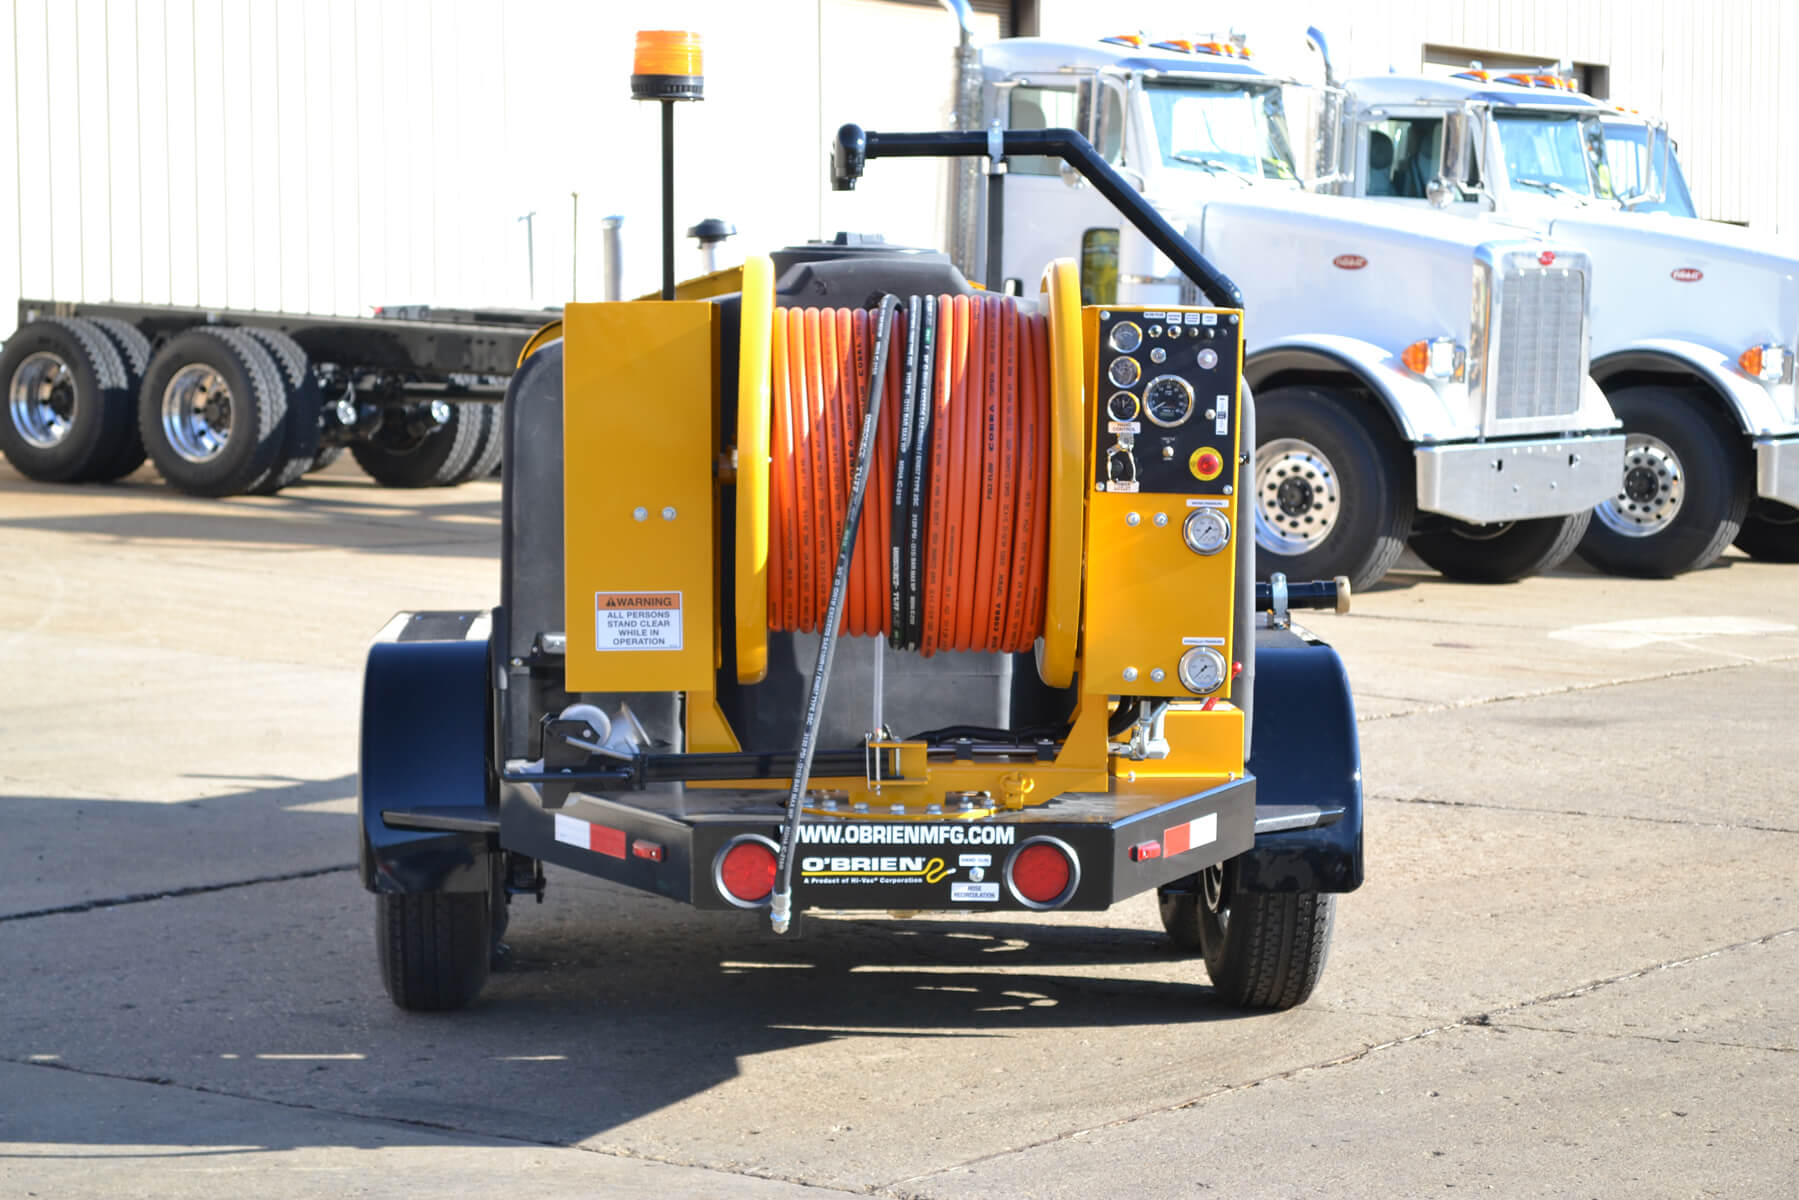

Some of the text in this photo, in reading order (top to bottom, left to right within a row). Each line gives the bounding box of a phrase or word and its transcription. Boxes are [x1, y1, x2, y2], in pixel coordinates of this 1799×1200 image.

[616, 597, 672, 607] WARNING
[627, 611, 670, 619] PERSONS
[607, 620, 637, 628] STAND
[824, 606, 835, 636] EXCEEDS
[802, 857, 923, 871] O'BRIEN
[880, 877, 922, 885] Corporation
